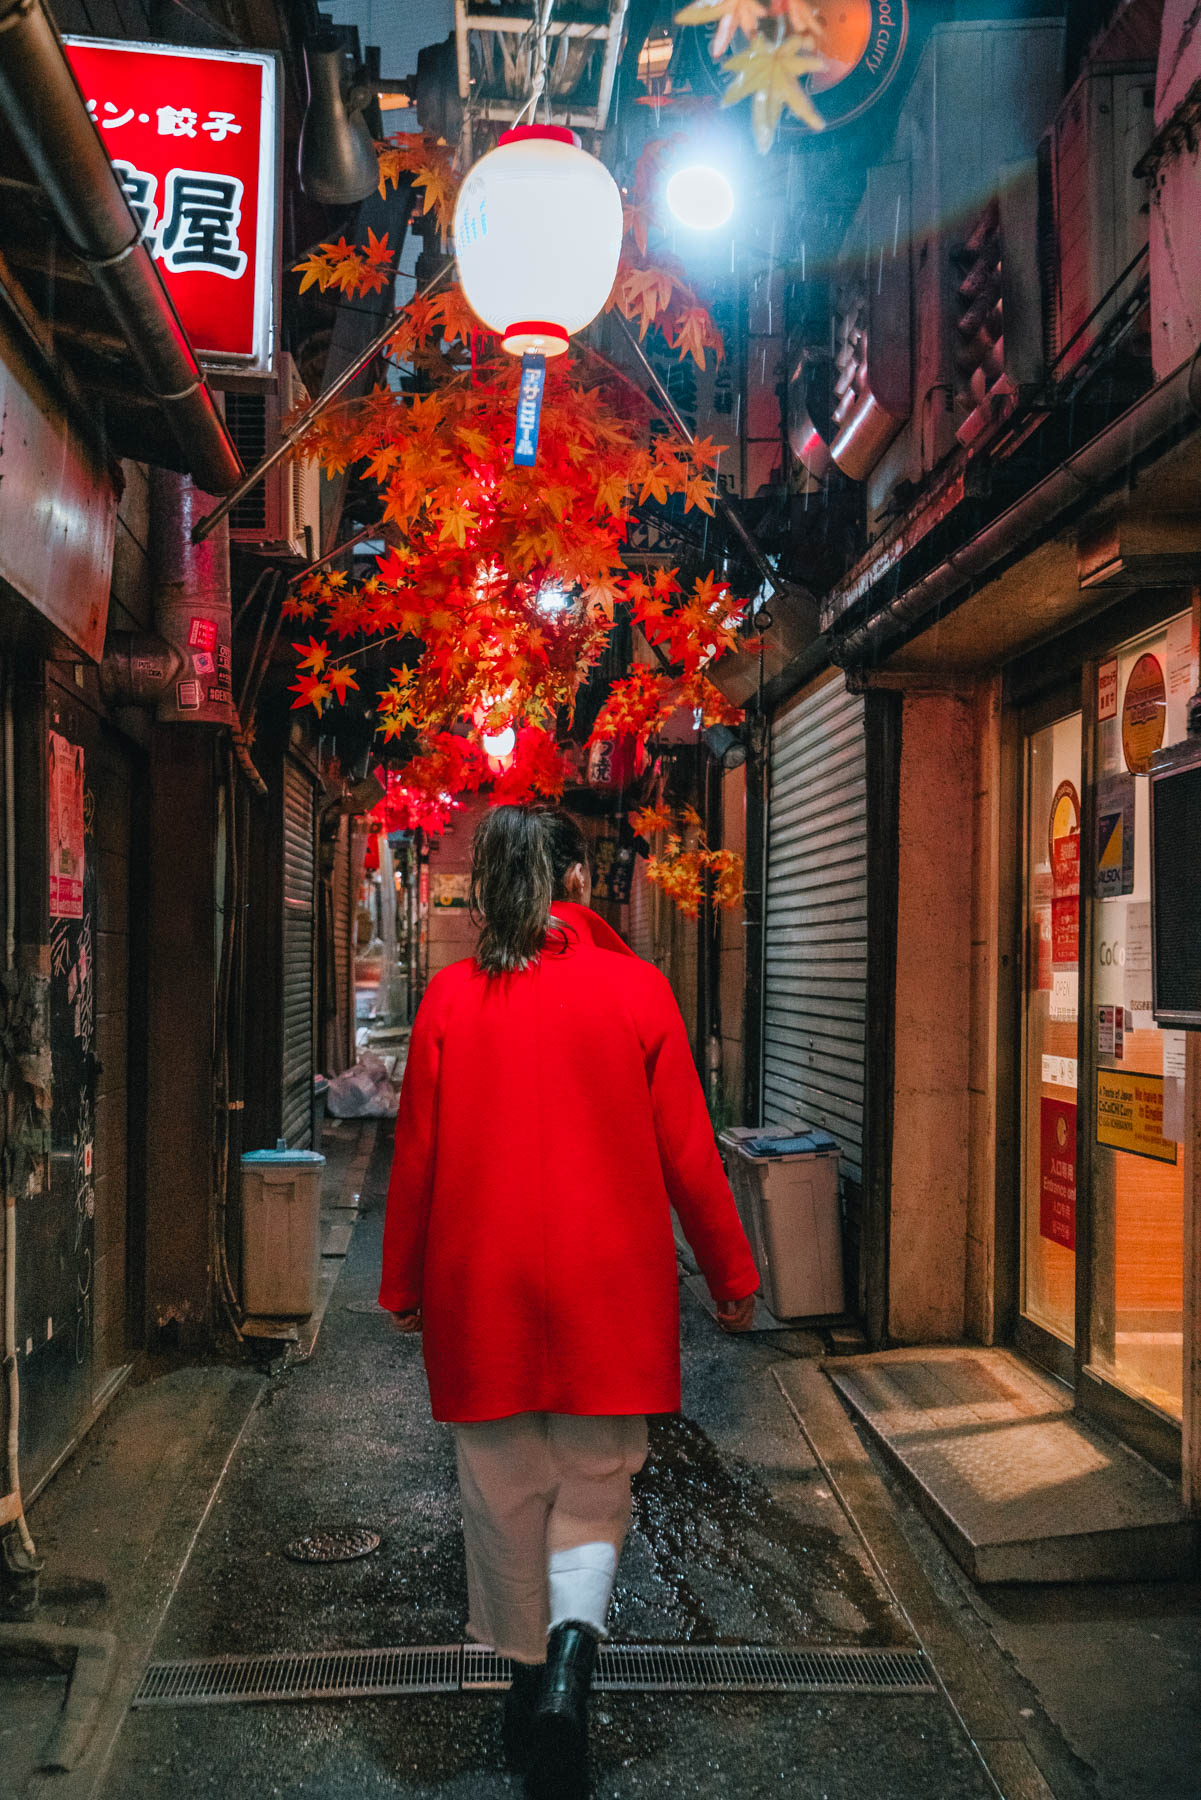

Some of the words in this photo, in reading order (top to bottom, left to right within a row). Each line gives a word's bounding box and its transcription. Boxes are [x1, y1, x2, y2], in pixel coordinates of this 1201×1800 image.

[865, 30, 890, 75] curry
[1055, 980, 1071, 997] OPEN
[1043, 1176, 1067, 1197] Entrance
